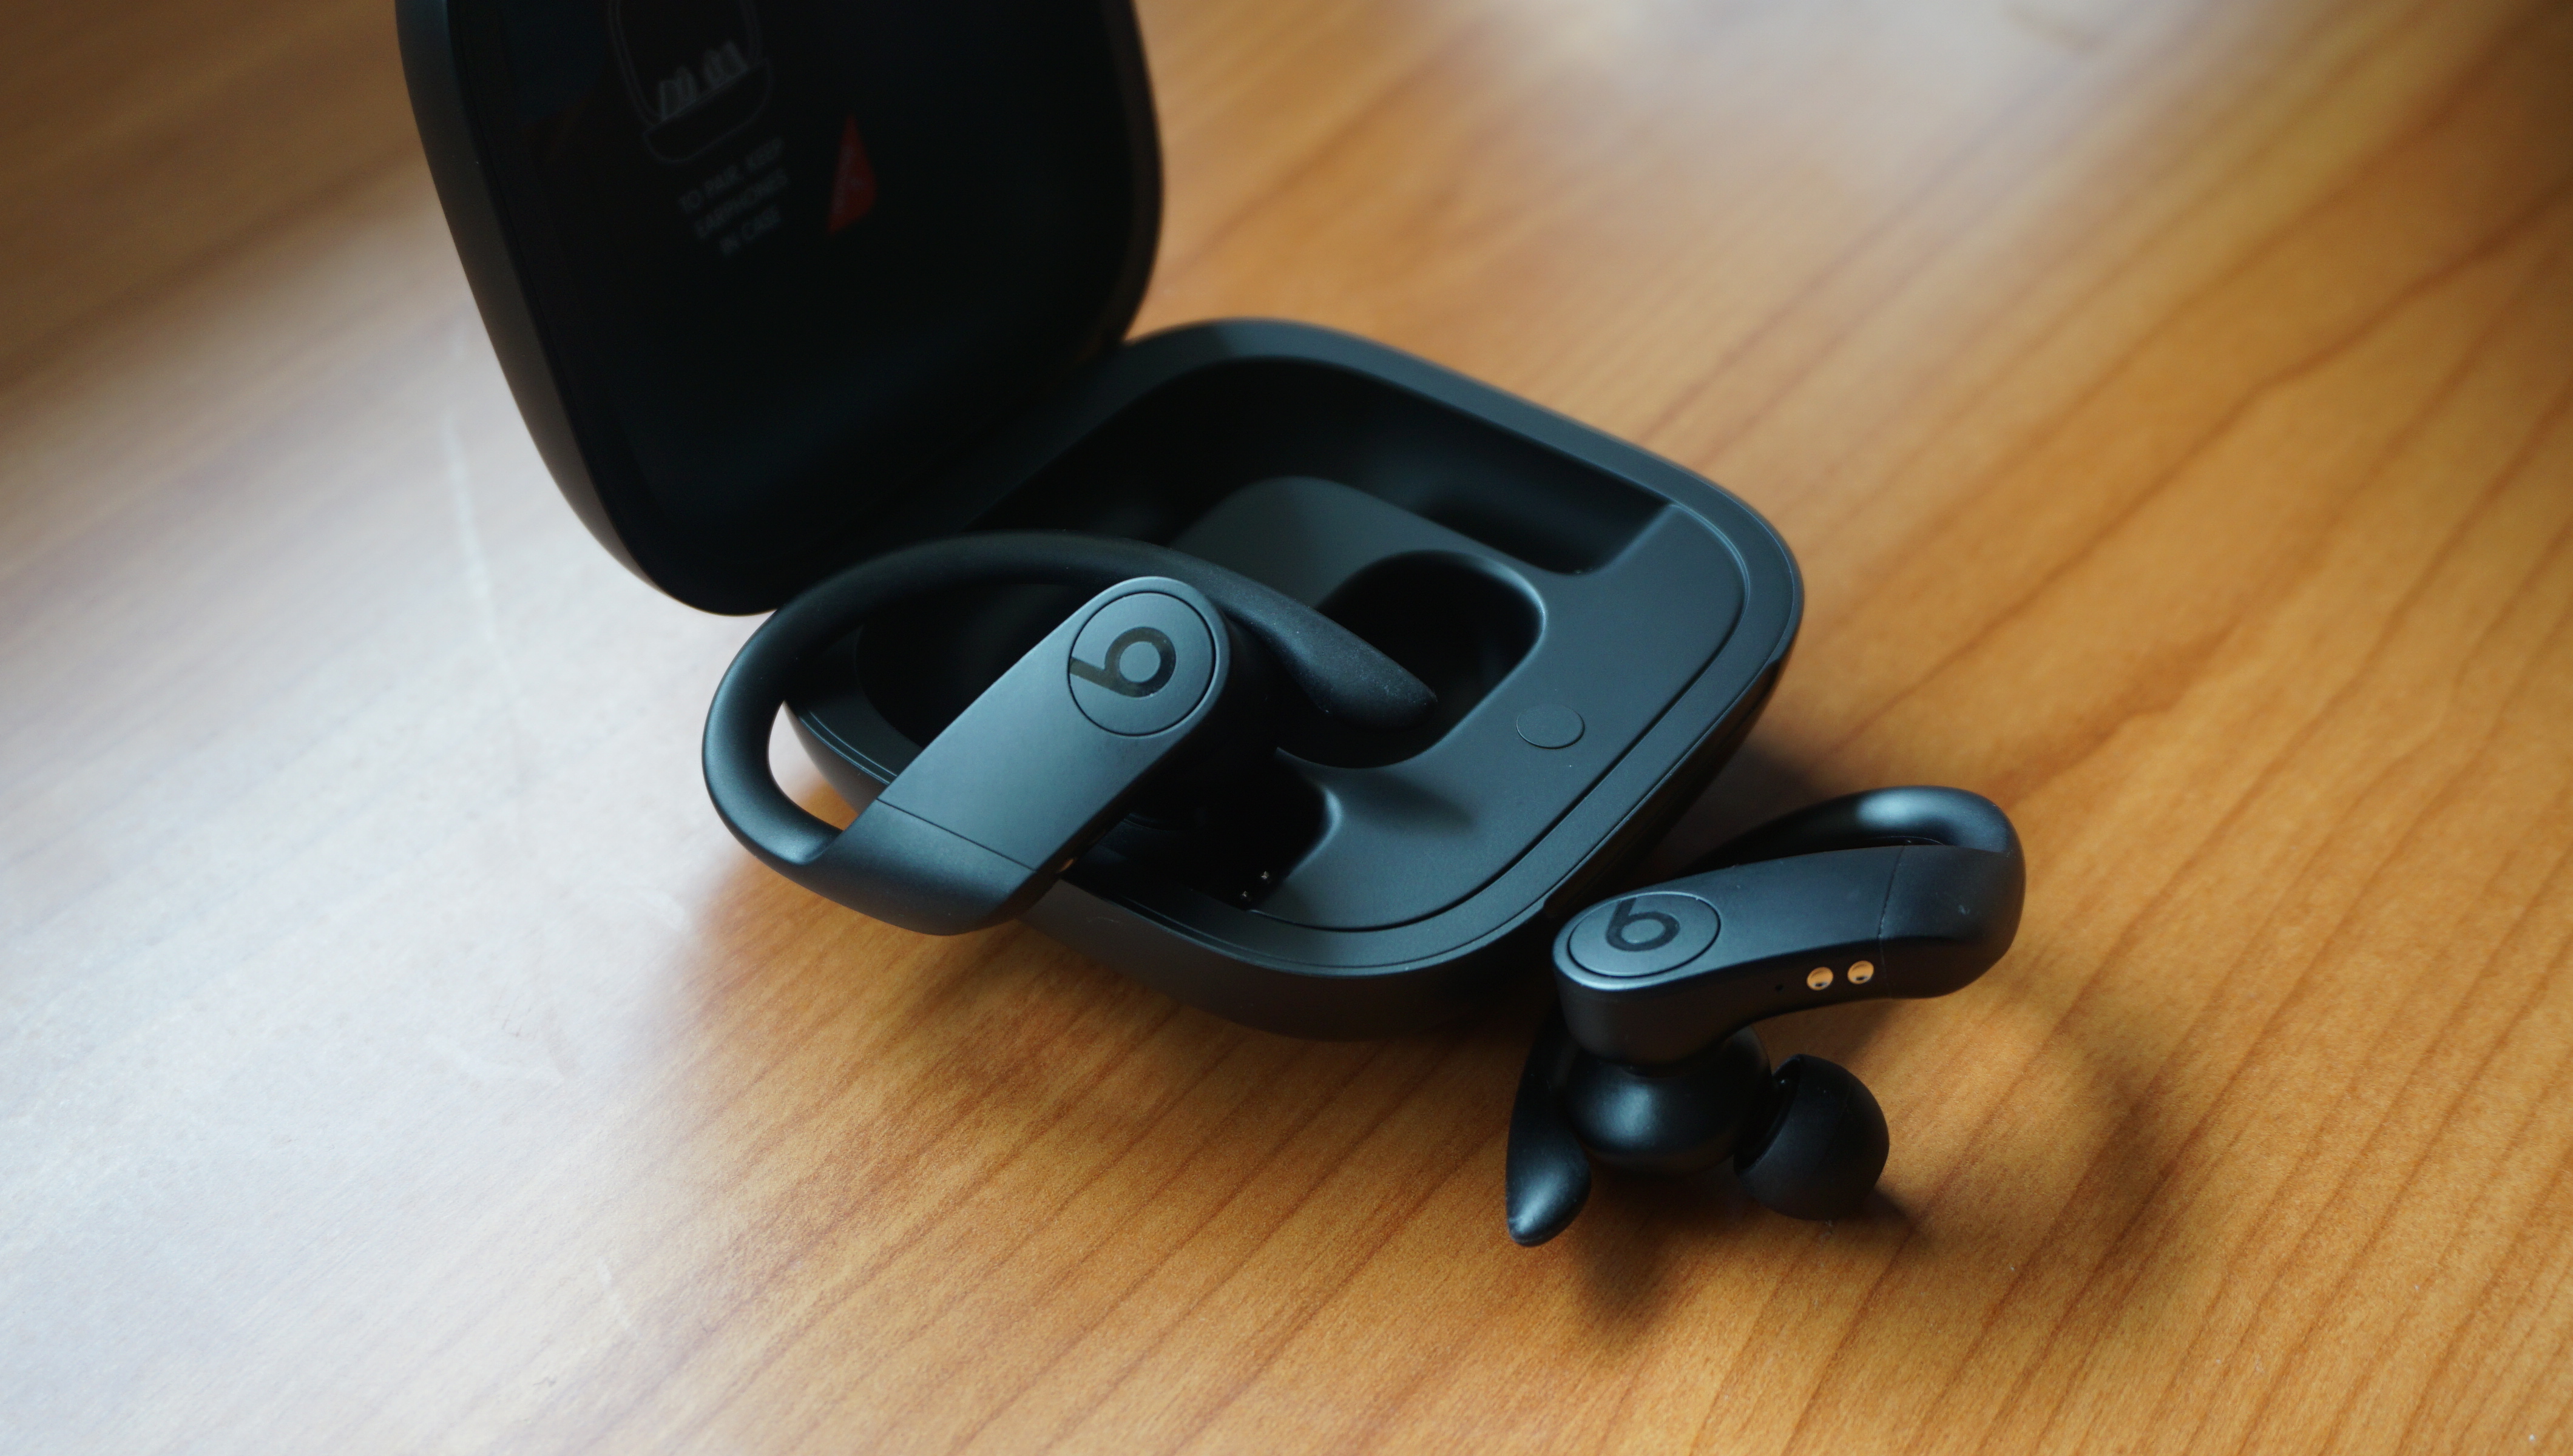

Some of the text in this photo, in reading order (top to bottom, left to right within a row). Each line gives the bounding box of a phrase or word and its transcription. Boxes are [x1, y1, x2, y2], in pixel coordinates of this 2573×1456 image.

[677, 187, 703, 214] TO
[744, 137, 785, 172] KEEP
[693, 169, 788, 239] EARPHONES
[741, 205, 780, 243] CASE
